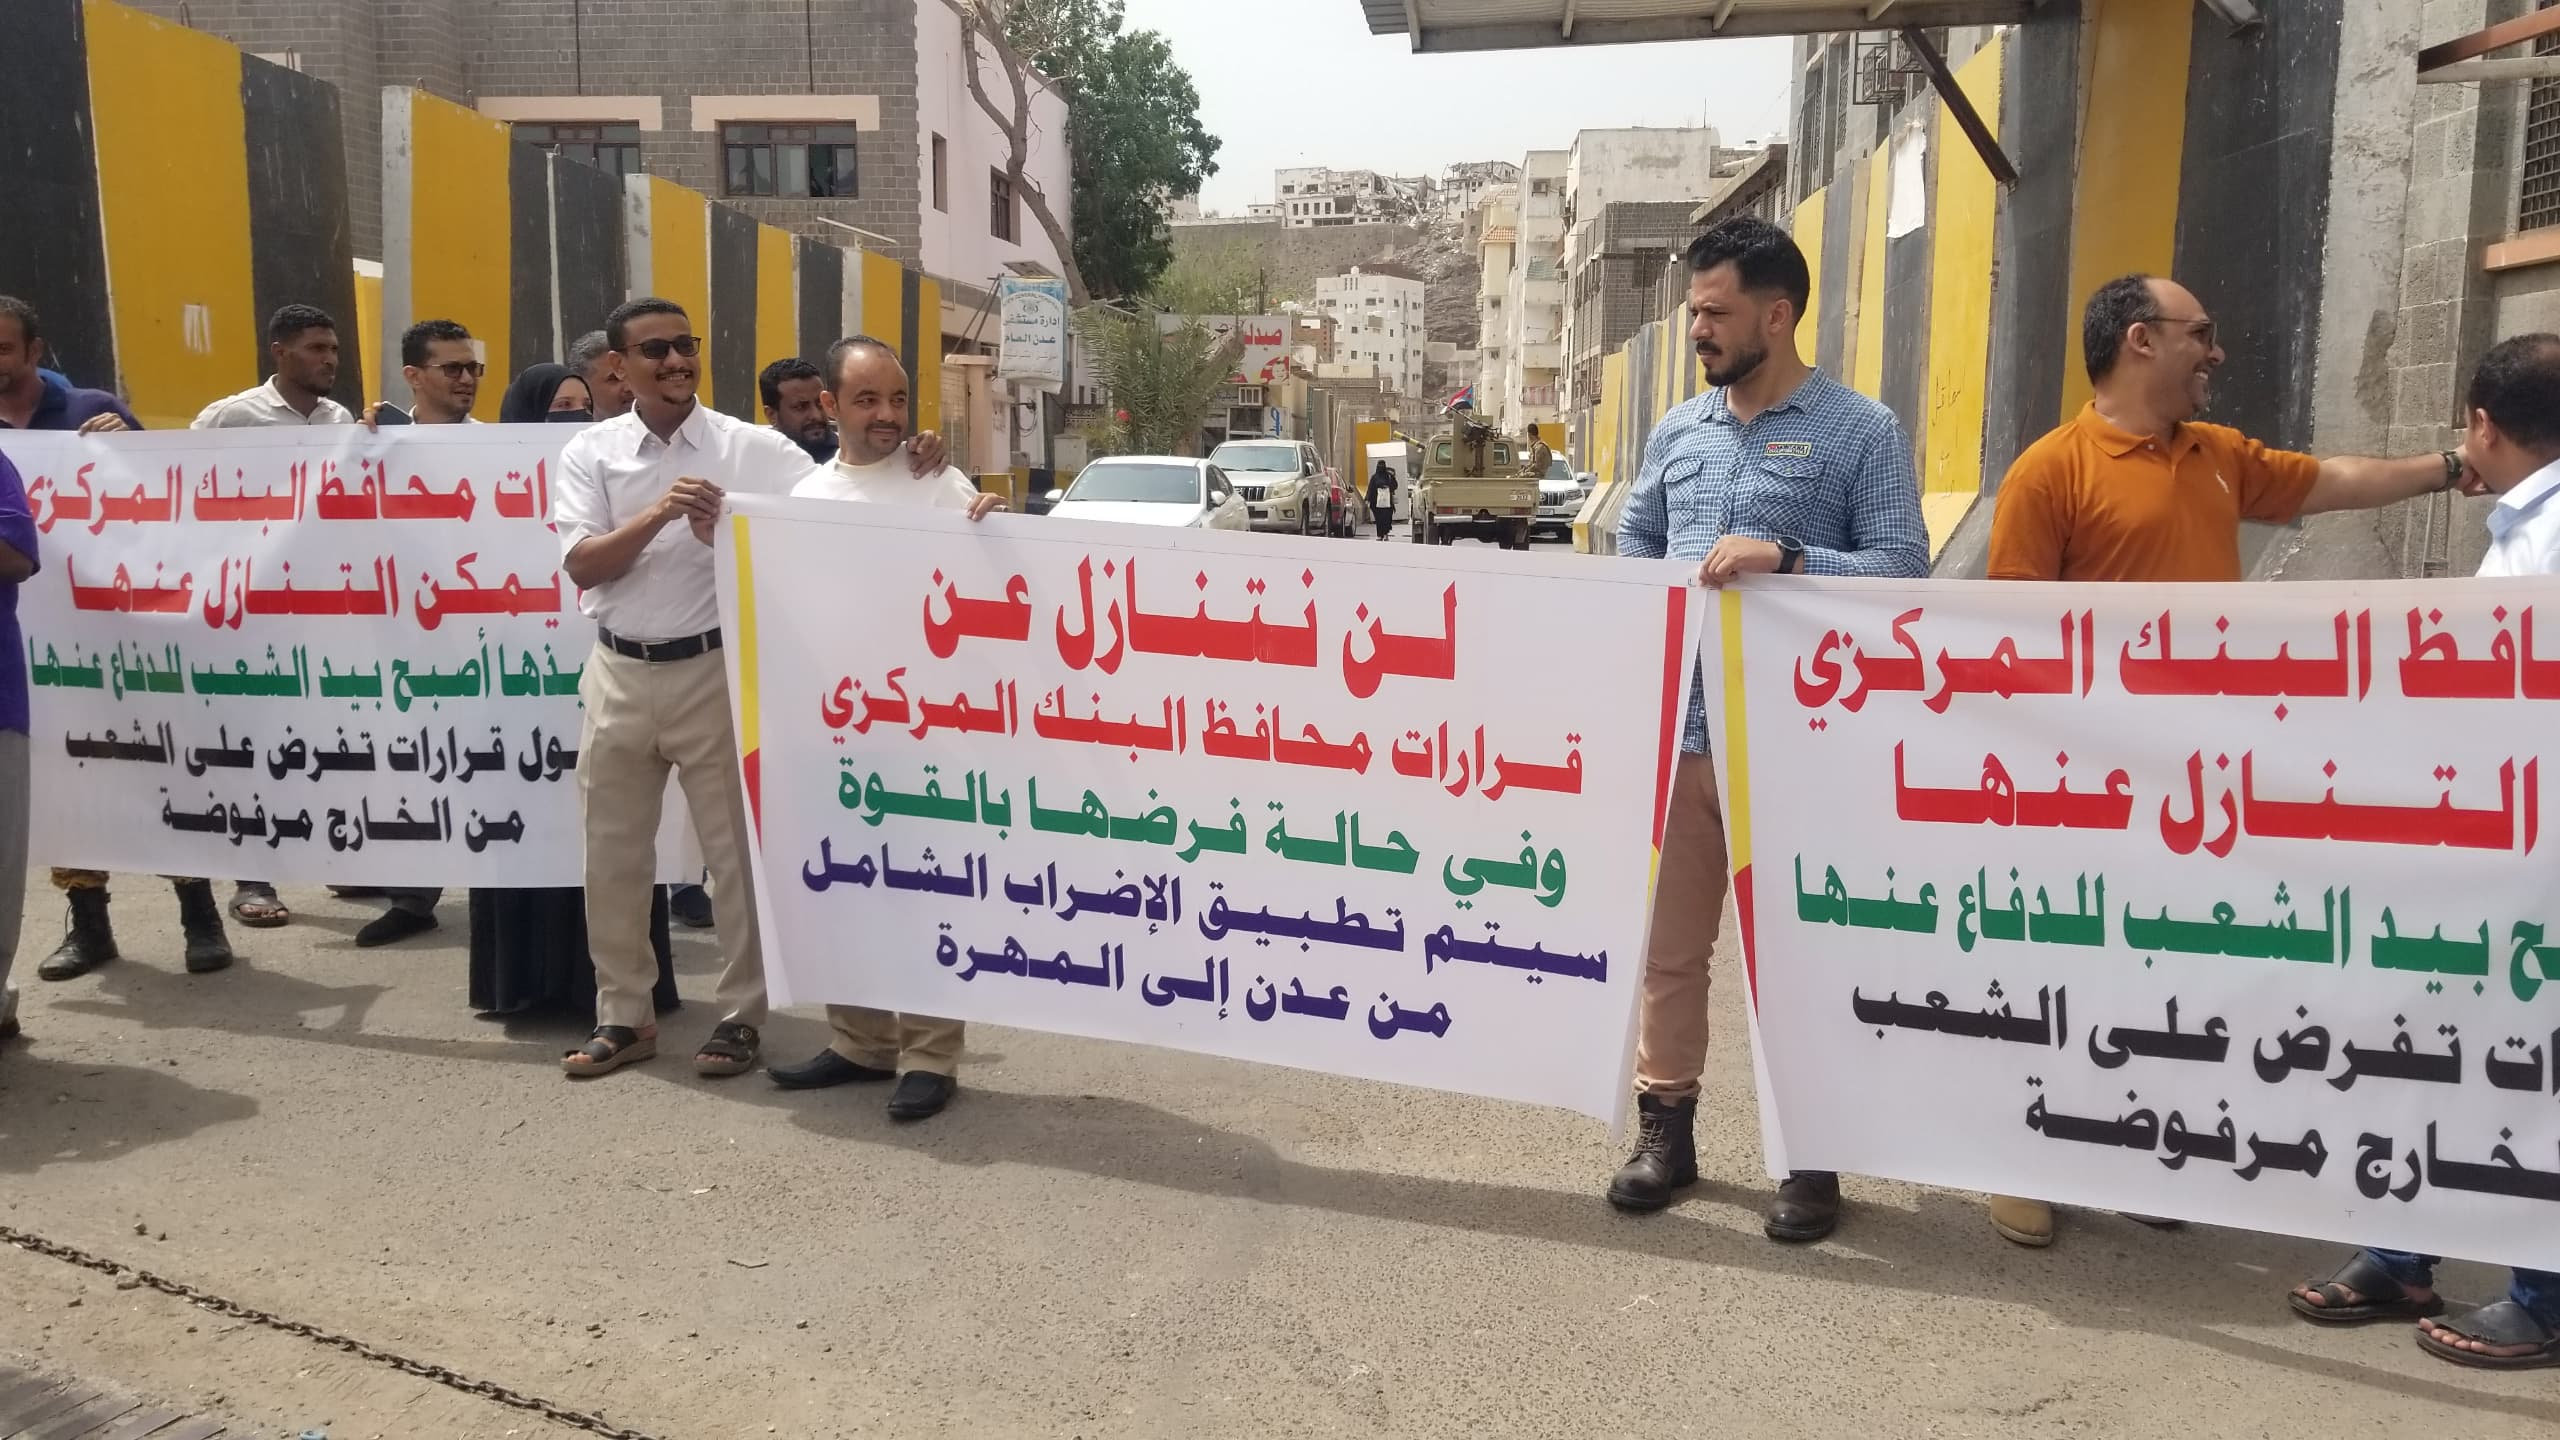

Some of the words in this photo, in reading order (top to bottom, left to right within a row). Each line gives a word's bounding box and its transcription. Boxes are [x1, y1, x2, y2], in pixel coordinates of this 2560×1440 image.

[194, 460, 307, 535] البنك
[317, 459, 476, 522] محافظ
[67, 554, 193, 613] عنها
[203, 555, 399, 630] التنازل
[415, 553, 560, 630] يمكن
[924, 569, 1031, 658] عن
[1056, 554, 1318, 675] نتنازل
[29, 636, 104, 689] عنها
[111, 640, 184, 701] للدفاع
[191, 645, 310, 706] الشعب
[393, 627, 491, 712] أصبح
[1343, 580, 1457, 698] لن
[1794, 608, 2093, 730] المركزي
[2120, 609, 2371, 720] البنك
[2399, 606, 2560, 699] افظ
[319, 657, 383, 711] بيد
[499, 643, 584, 709] يذها
[822, 668, 1017, 743] المركزي
[66, 720, 175, 768] الشعب
[185, 725, 254, 777] على
[267, 726, 376, 782] تفرض
[388, 727, 505, 783] قرارات
[519, 727, 579, 782] ول
[1034, 686, 1186, 762] البنك
[1203, 699, 1372, 774] محافظ
[1392, 722, 1582, 800] قرارات
[1895, 741, 2133, 829] عنها
[160, 787, 313, 849] مرفوضة
[327, 797, 451, 851] الخارج
[465, 810, 524, 852] من
[839, 759, 1011, 838] بالقوة
[1029, 778, 1246, 862] فرضها
[2160, 751, 2538, 858] التنازل
[803, 837, 987, 900] الشامل
[1266, 803, 1419, 873] حالة
[1444, 832, 1566, 909] وفي
[1005, 862, 1181, 934] الإضراب
[1199, 882, 1404, 952] تطبيق
[1794, 853, 1938, 934] عنها
[1957, 866, 2105, 952] للدفاع
[2123, 881, 2351, 969] الشعب
[937, 923, 1124, 990] المهرة
[1425, 922, 1607, 984] سيتم
[2371, 906, 2490, 995] بيد
[1142, 956, 1228, 1019] إلى
[1246, 976, 1349, 1021] عدن
[1368, 993, 1451, 1039] من
[1853, 980, 2067, 1049] الشعب
[2089, 996, 2229, 1068] على
[2254, 1006, 2461, 1091] تفرض
[2026, 1076, 2328, 1181] مرفوضة
[2356, 1121, 2560, 1202] خارج
